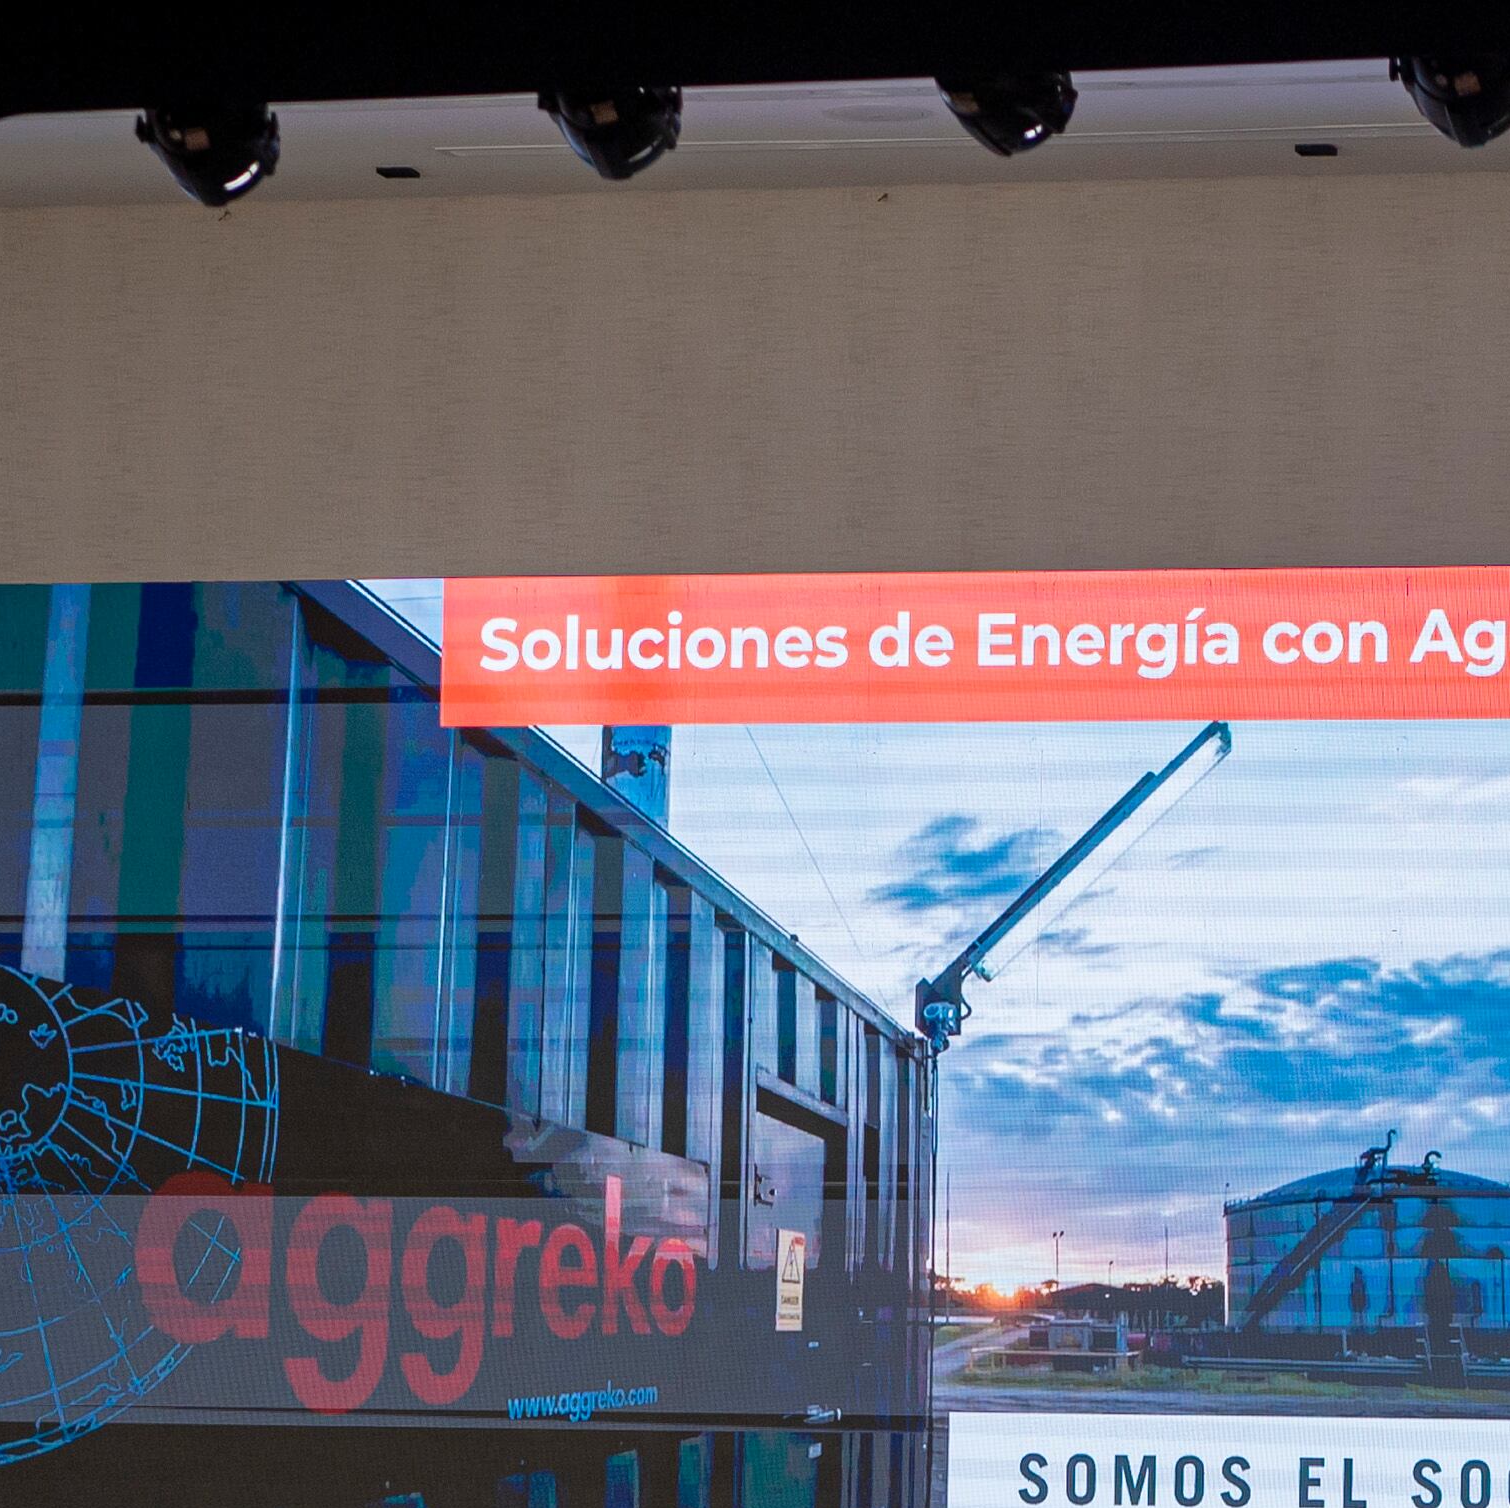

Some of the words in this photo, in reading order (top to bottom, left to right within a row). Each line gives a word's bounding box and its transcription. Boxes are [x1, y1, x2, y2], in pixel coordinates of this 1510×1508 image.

[478, 610, 849, 672] Soluciones
[868, 611, 955, 668] de
[977, 607, 1240, 680] Energía
[1261, 616, 1389, 665] con
[133, 1170, 697, 1415] aggreko
[507, 1379, 658, 1423] www.aggreko.com
[1017, 1451, 1253, 1508] SOMOS
